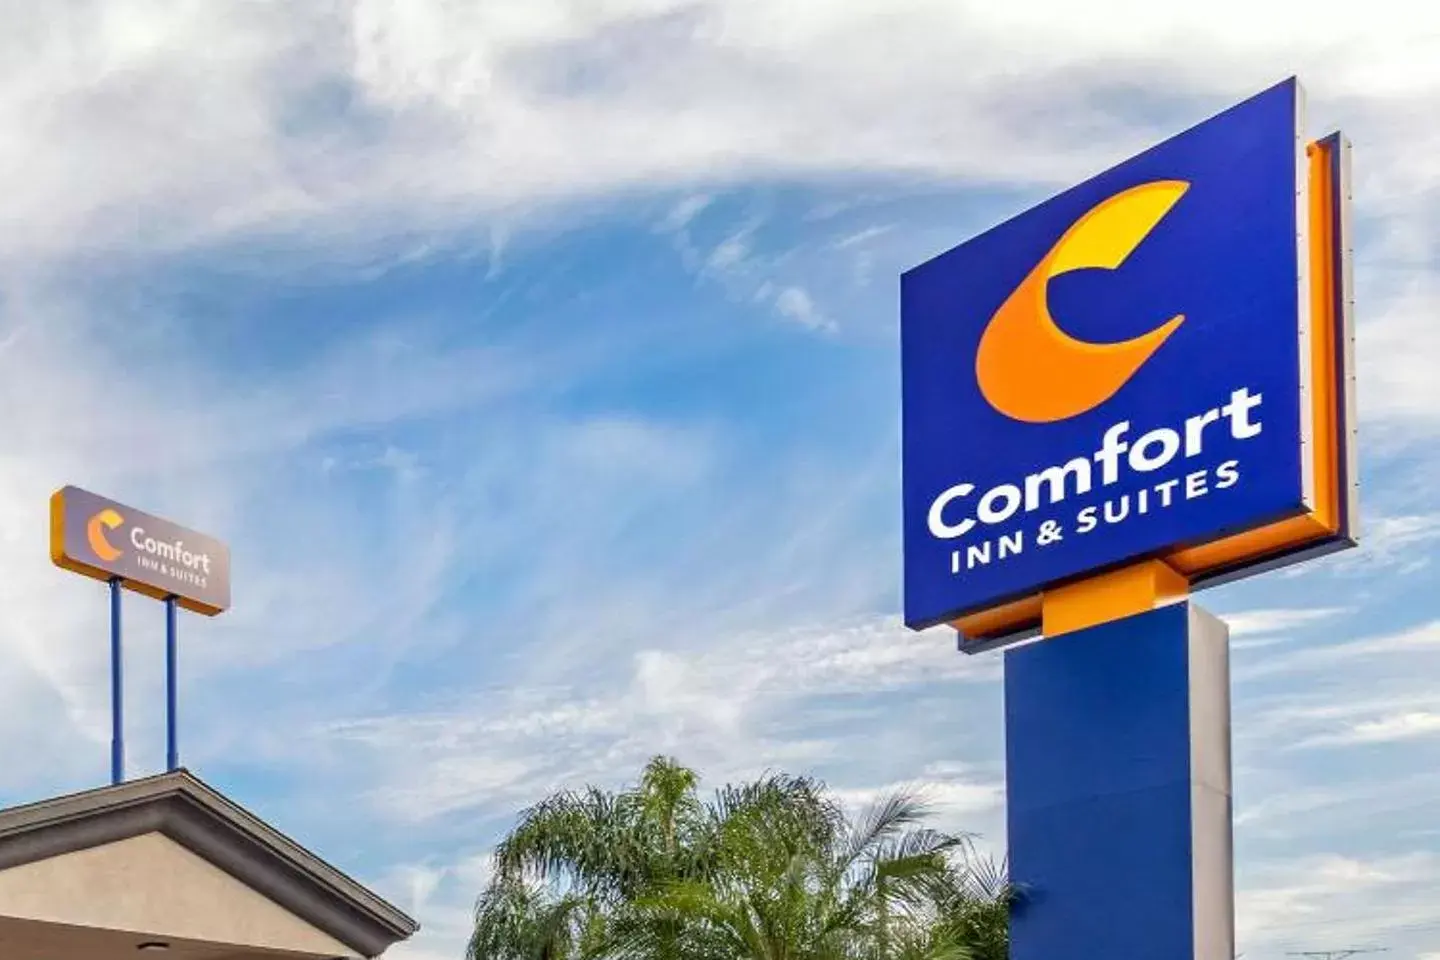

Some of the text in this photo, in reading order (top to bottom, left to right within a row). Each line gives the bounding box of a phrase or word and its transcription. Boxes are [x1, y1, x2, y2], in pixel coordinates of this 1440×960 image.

[928, 387, 1262, 539] Comfort
[951, 460, 1239, 574] INN & SUITES
[130, 526, 211, 576] Comfort
